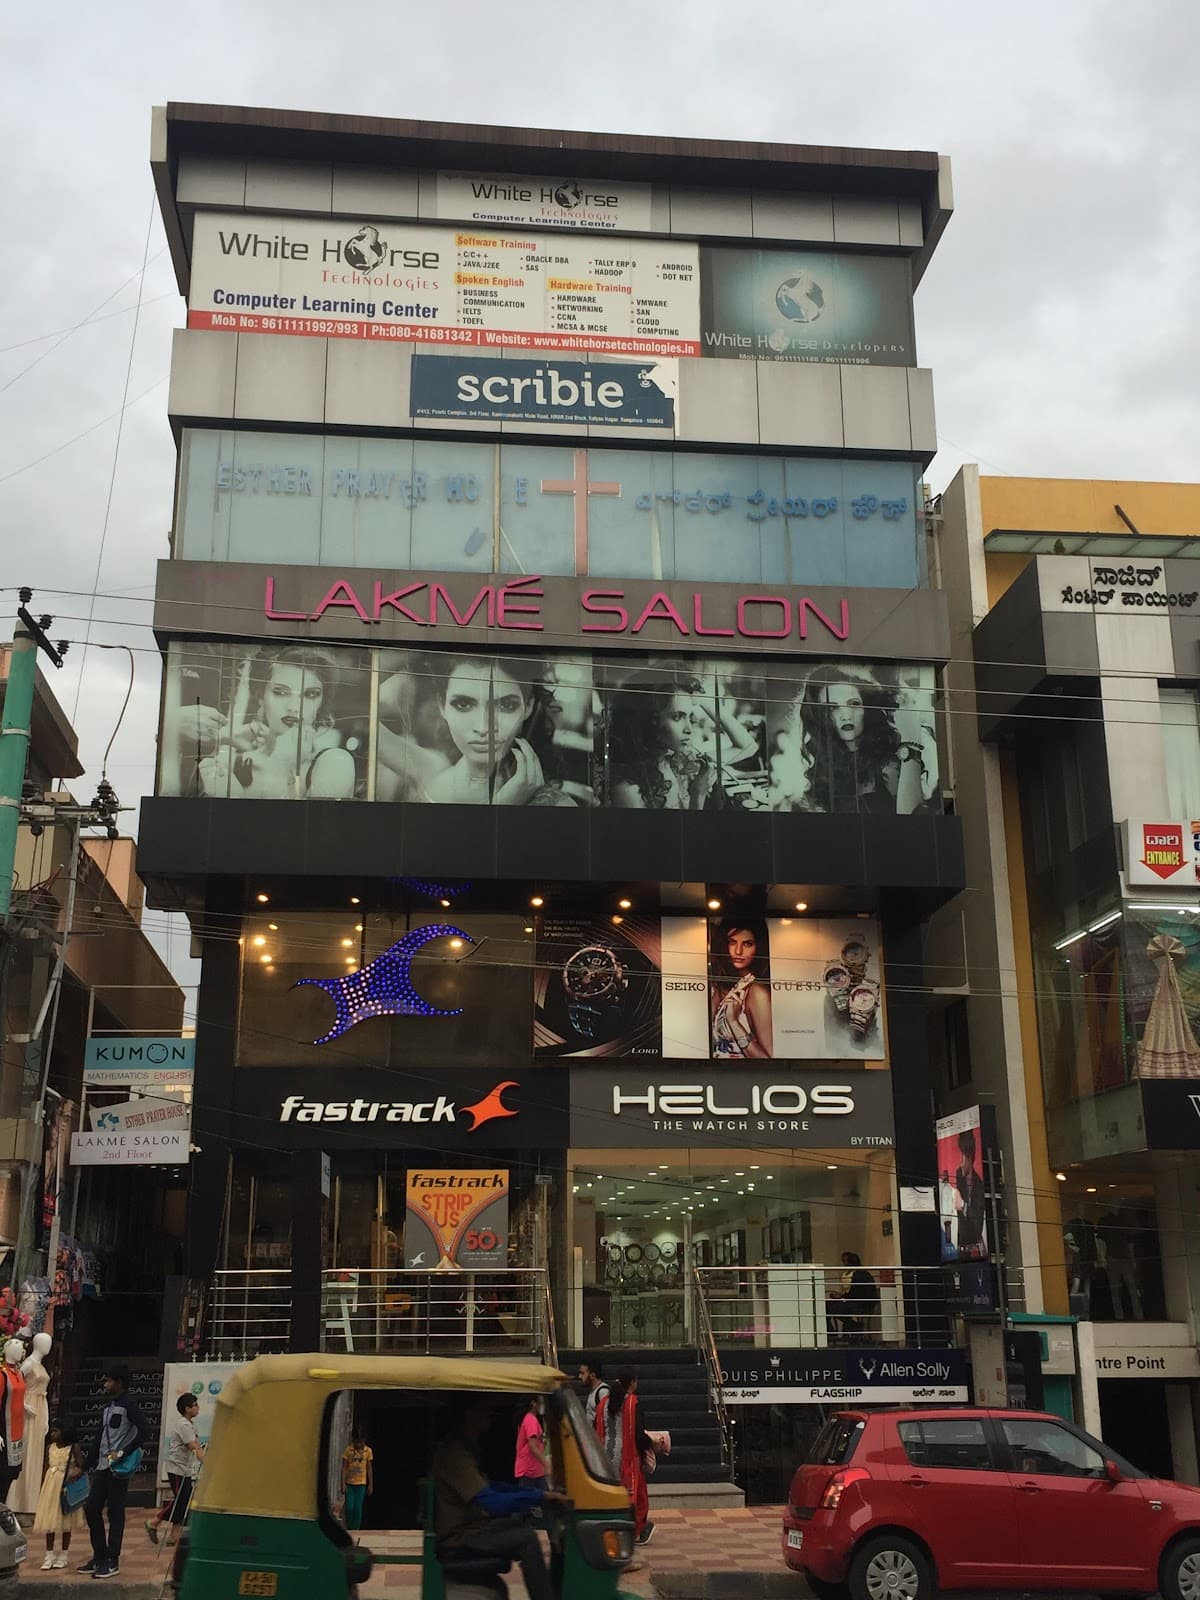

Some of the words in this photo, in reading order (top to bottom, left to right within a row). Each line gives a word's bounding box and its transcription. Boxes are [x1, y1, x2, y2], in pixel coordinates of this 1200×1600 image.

[471, 183, 531, 202] White
[472, 212, 525, 223] Computer
[529, 216, 577, 227] Learning
[580, 220, 617, 228] Center
[218, 231, 309, 261] White
[457, 236, 497, 248] Software
[500, 240, 537, 251] Training
[525, 255, 553, 263] ORACLE
[555, 256, 569, 264] DBA
[594, 259, 614, 267] TALLY
[662, 263, 693, 271] ANDROID
[594, 269, 624, 277] HADOOP
[662, 273, 677, 281] DOT
[457, 274, 489, 286] Spoken
[492, 277, 525, 288] English
[550, 279, 593, 291] Hardware
[596, 283, 632, 295] Training
[463, 289, 498, 297] BUSINESS
[213, 288, 297, 310] Computer
[302, 295, 376, 318] Learning
[382, 301, 439, 319] Center
[463, 298, 525, 308] COMMUNICATION
[557, 295, 597, 303] HARDWARE
[636, 299, 668, 307] VMWARE
[462, 307, 482, 315] IELTS
[557, 304, 603, 313] NETWORKING
[636, 308, 651, 316] SAN
[462, 317, 484, 325] TOEFL
[557, 314, 577, 322] CCNA
[636, 318, 660, 326] CLOUD
[557, 323, 578, 331] MCSA
[637, 327, 680, 336] COMPUTING
[211, 314, 236, 328] Mob
[239, 316, 258, 329] No:
[261, 318, 358, 335] 9611111992/993
[371, 326, 472, 342] Ph:080-41681342
[486, 332, 531, 345] Website:
[534, 336, 695, 354] www.whitehorsetechnologies.in
[705, 331, 752, 349] White
[457, 368, 625, 409] scribie
[216, 463, 312, 496] ESTHER
[264, 575, 545, 630] LAKMÉ
[581, 590, 850, 640] SALON
[1146, 850, 1180, 865] ENTRANCE
[664, 982, 706, 992] SEIKO
[772, 981, 822, 992] GUESS
[96, 1043, 186, 1064] KUMON
[87, 1072, 149, 1080] MATHEMATICS
[153, 1071, 192, 1080] ENGLISH
[612, 1085, 855, 1115] HELIOS
[280, 1096, 456, 1123] fastrack
[124, 1112, 146, 1129] ESTHER
[146, 1108, 166, 1124] PRAYER
[652, 1120, 684, 1130] THE
[692, 1120, 748, 1131] WATCH
[757, 1120, 810, 1131] STORE
[134, 1135, 180, 1146] SALON
[850, 1136, 864, 1145] BY
[865, 1136, 893, 1145] TITAN
[103, 1149, 121, 1160] 2nd
[127, 1149, 153, 1159] Floor
[411, 1173, 504, 1188] fastrack
[421, 1193, 473, 1211] STRIP
[434, 1211, 460, 1228] US
[1095, 1356, 1122, 1369] ntre
[1126, 1355, 1166, 1369] Point
[720, 1370, 759, 1382] OUIS
[765, 1369, 842, 1381] PHILIPPE
[879, 1361, 915, 1378] Allen
[916, 1362, 950, 1381] Solly
[810, 1388, 862, 1398] FLAGSHIP
